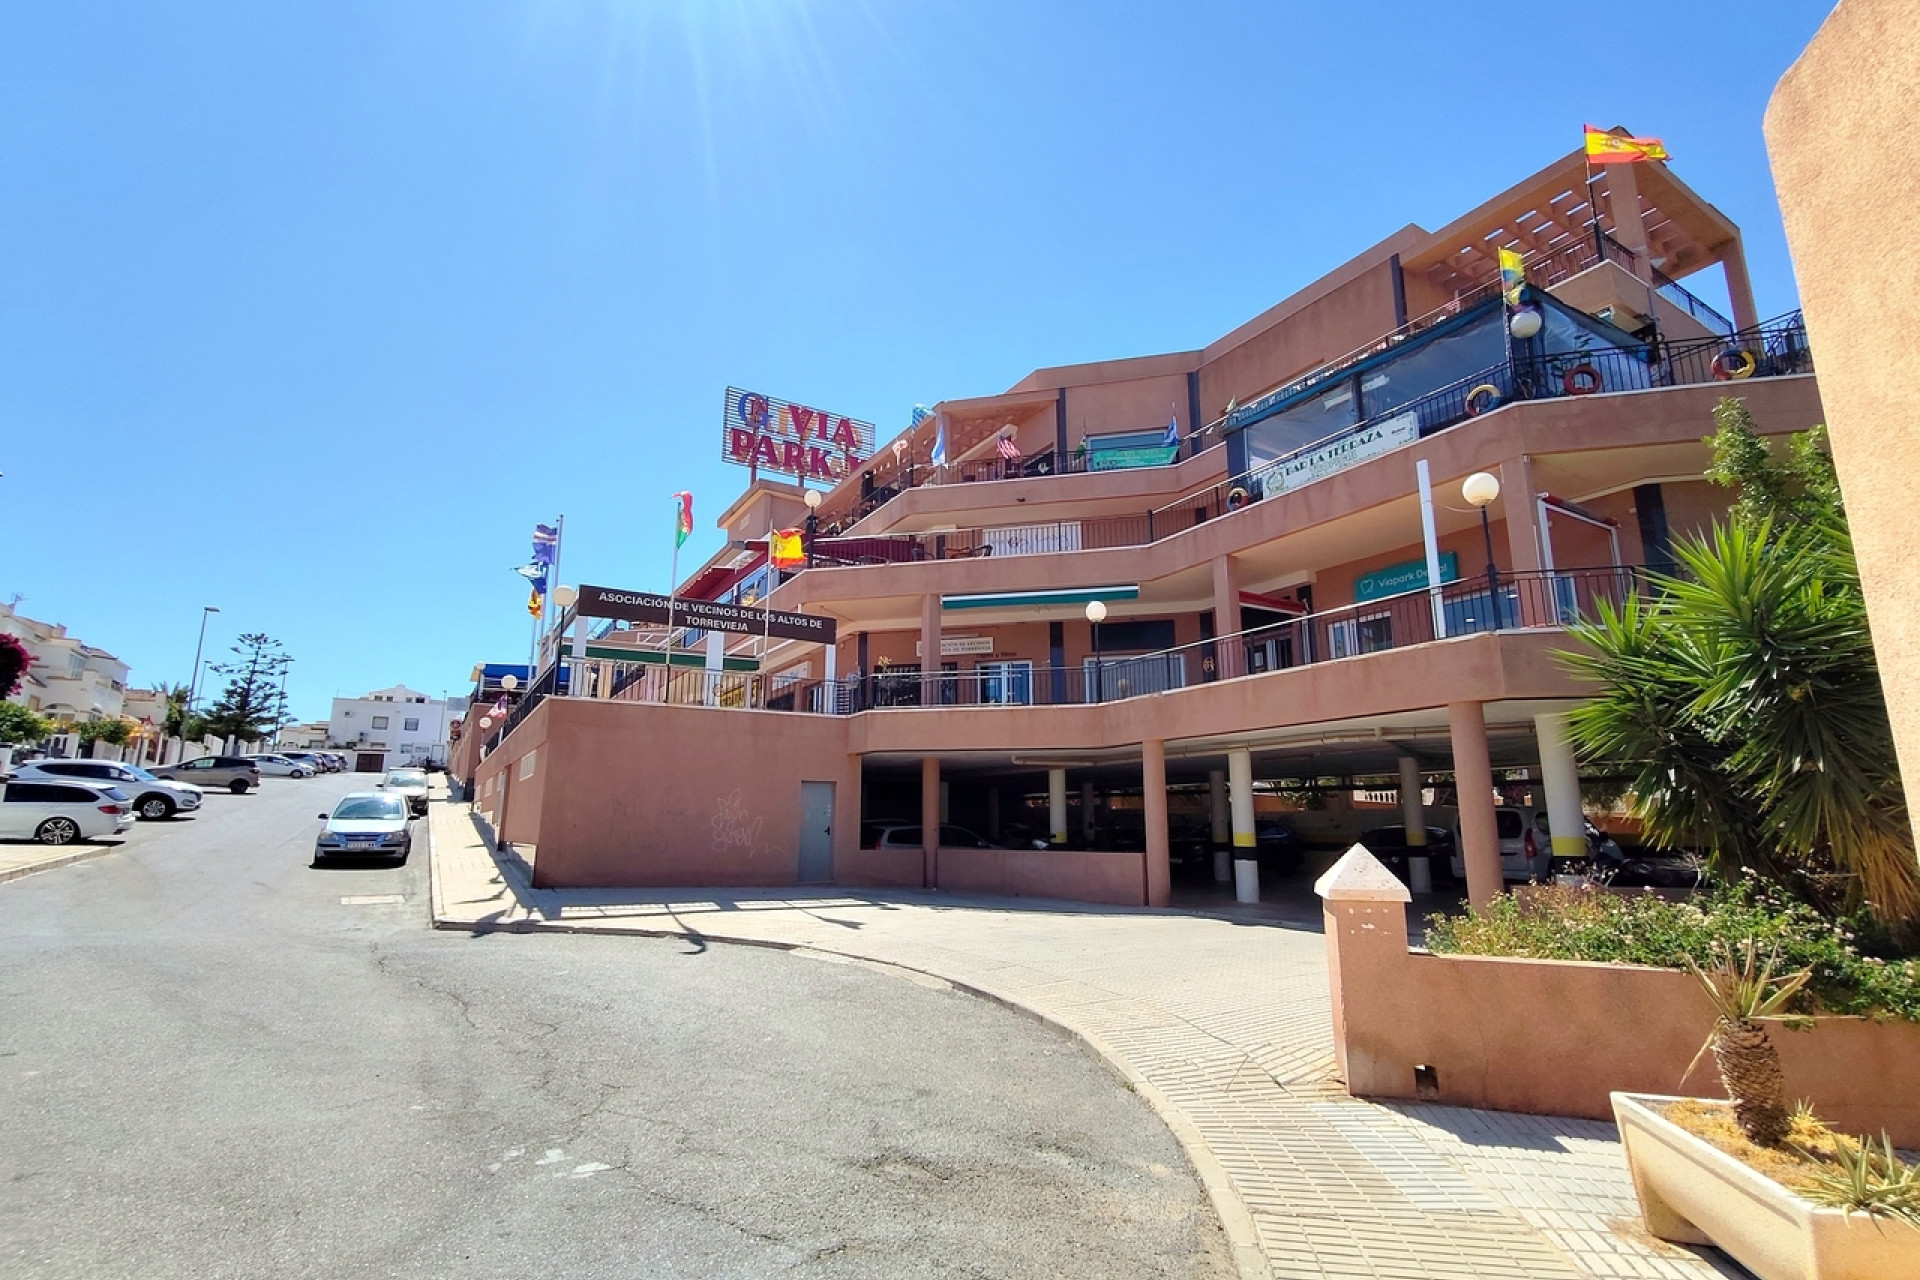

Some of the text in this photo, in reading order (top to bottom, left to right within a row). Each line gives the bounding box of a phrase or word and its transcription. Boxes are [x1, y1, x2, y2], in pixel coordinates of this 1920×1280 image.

[788, 404, 857, 449] VIA
[730, 428, 833, 478] PARK
[1378, 570, 1415, 587] Viapark
[1415, 562, 1447, 579] Deal
[598, 591, 823, 629] ASOCIACIÓN DE VECINOS DE LOS ALTOS DE
[685, 615, 748, 631] TORREVIEJA
